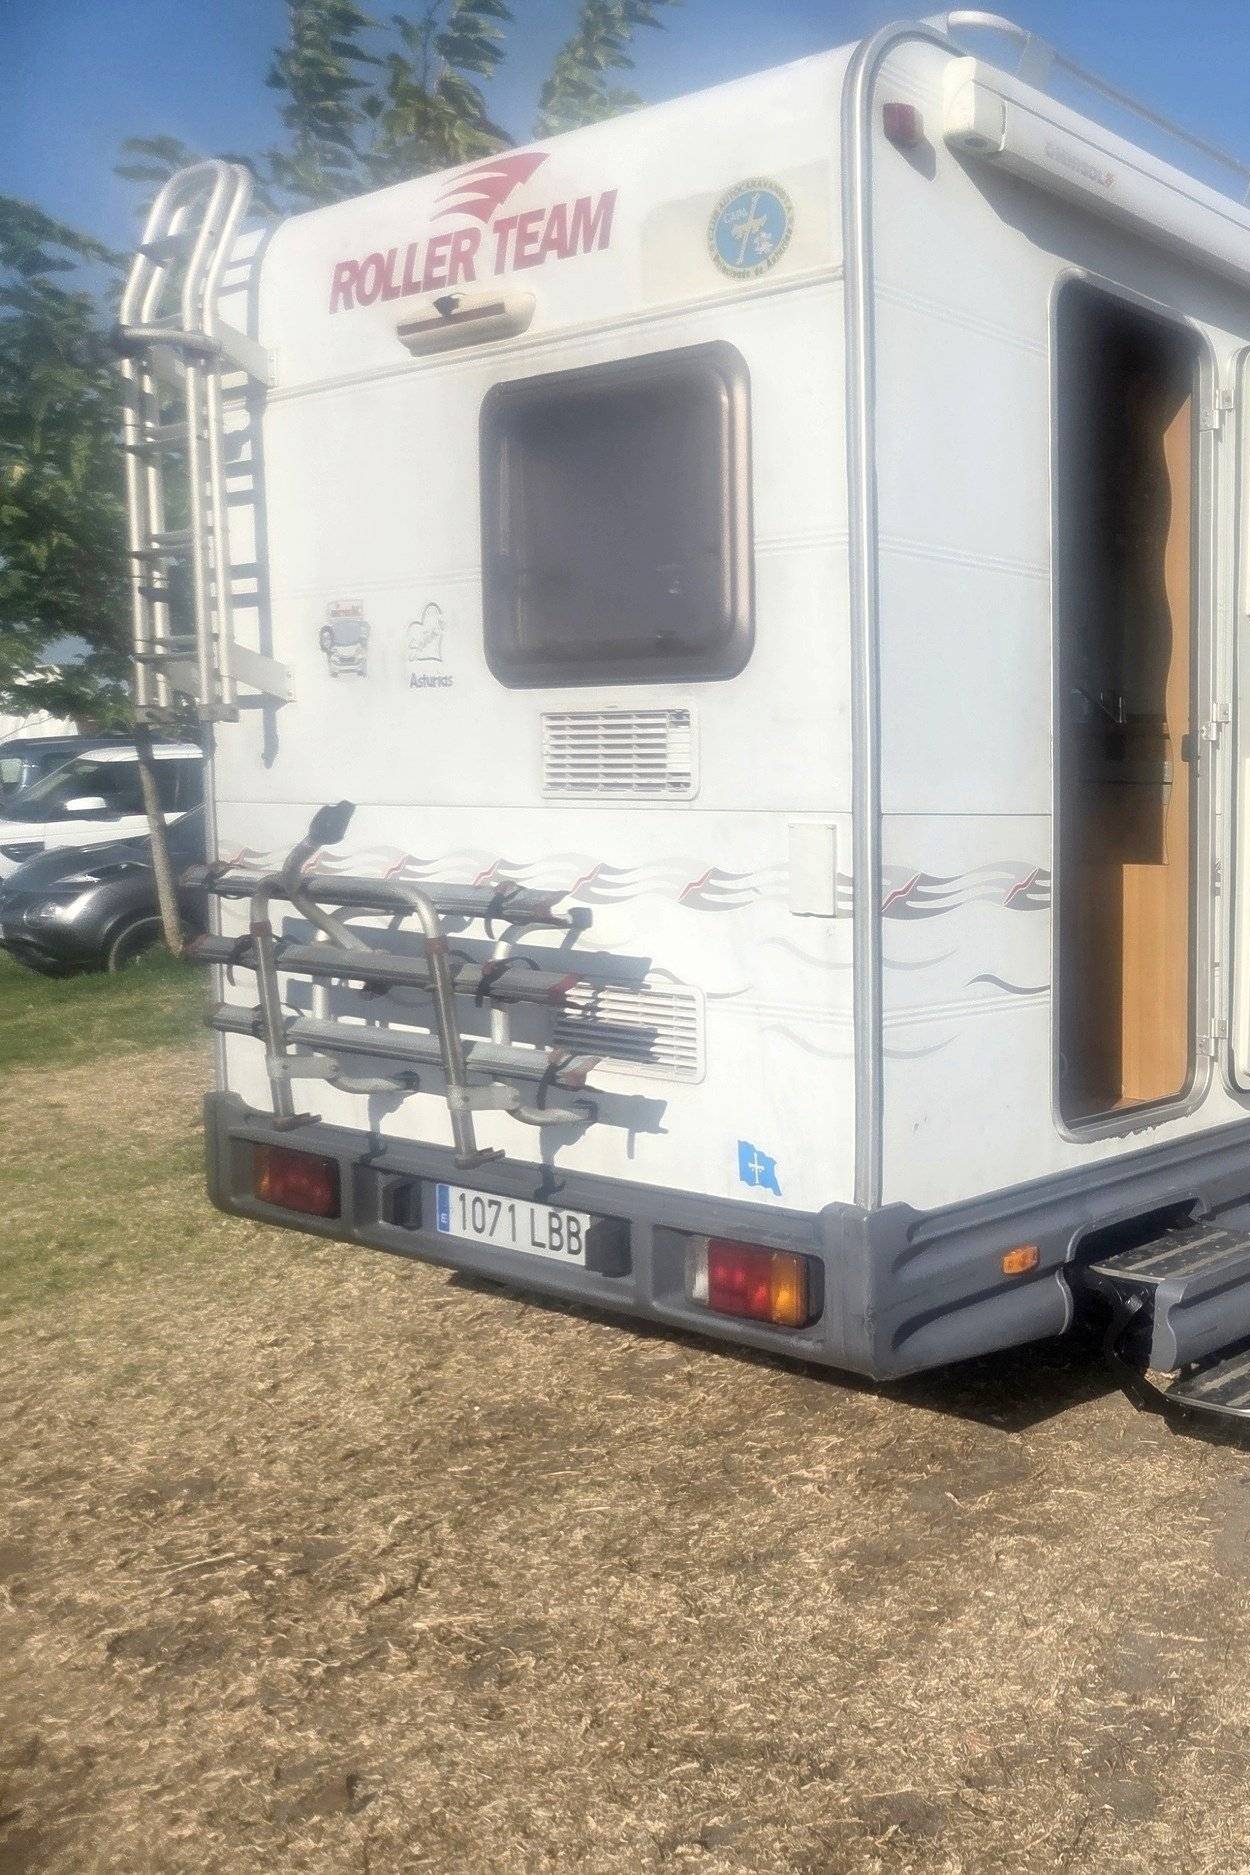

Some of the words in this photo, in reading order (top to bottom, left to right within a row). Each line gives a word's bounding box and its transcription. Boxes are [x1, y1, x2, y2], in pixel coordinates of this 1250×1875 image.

[329, 226, 482, 315] ROLLER
[493, 189, 618, 276] TEAM
[409, 673, 454, 689] Asturias
[458, 1192, 517, 1242] 1071
[530, 1208, 582, 1255] LBB
